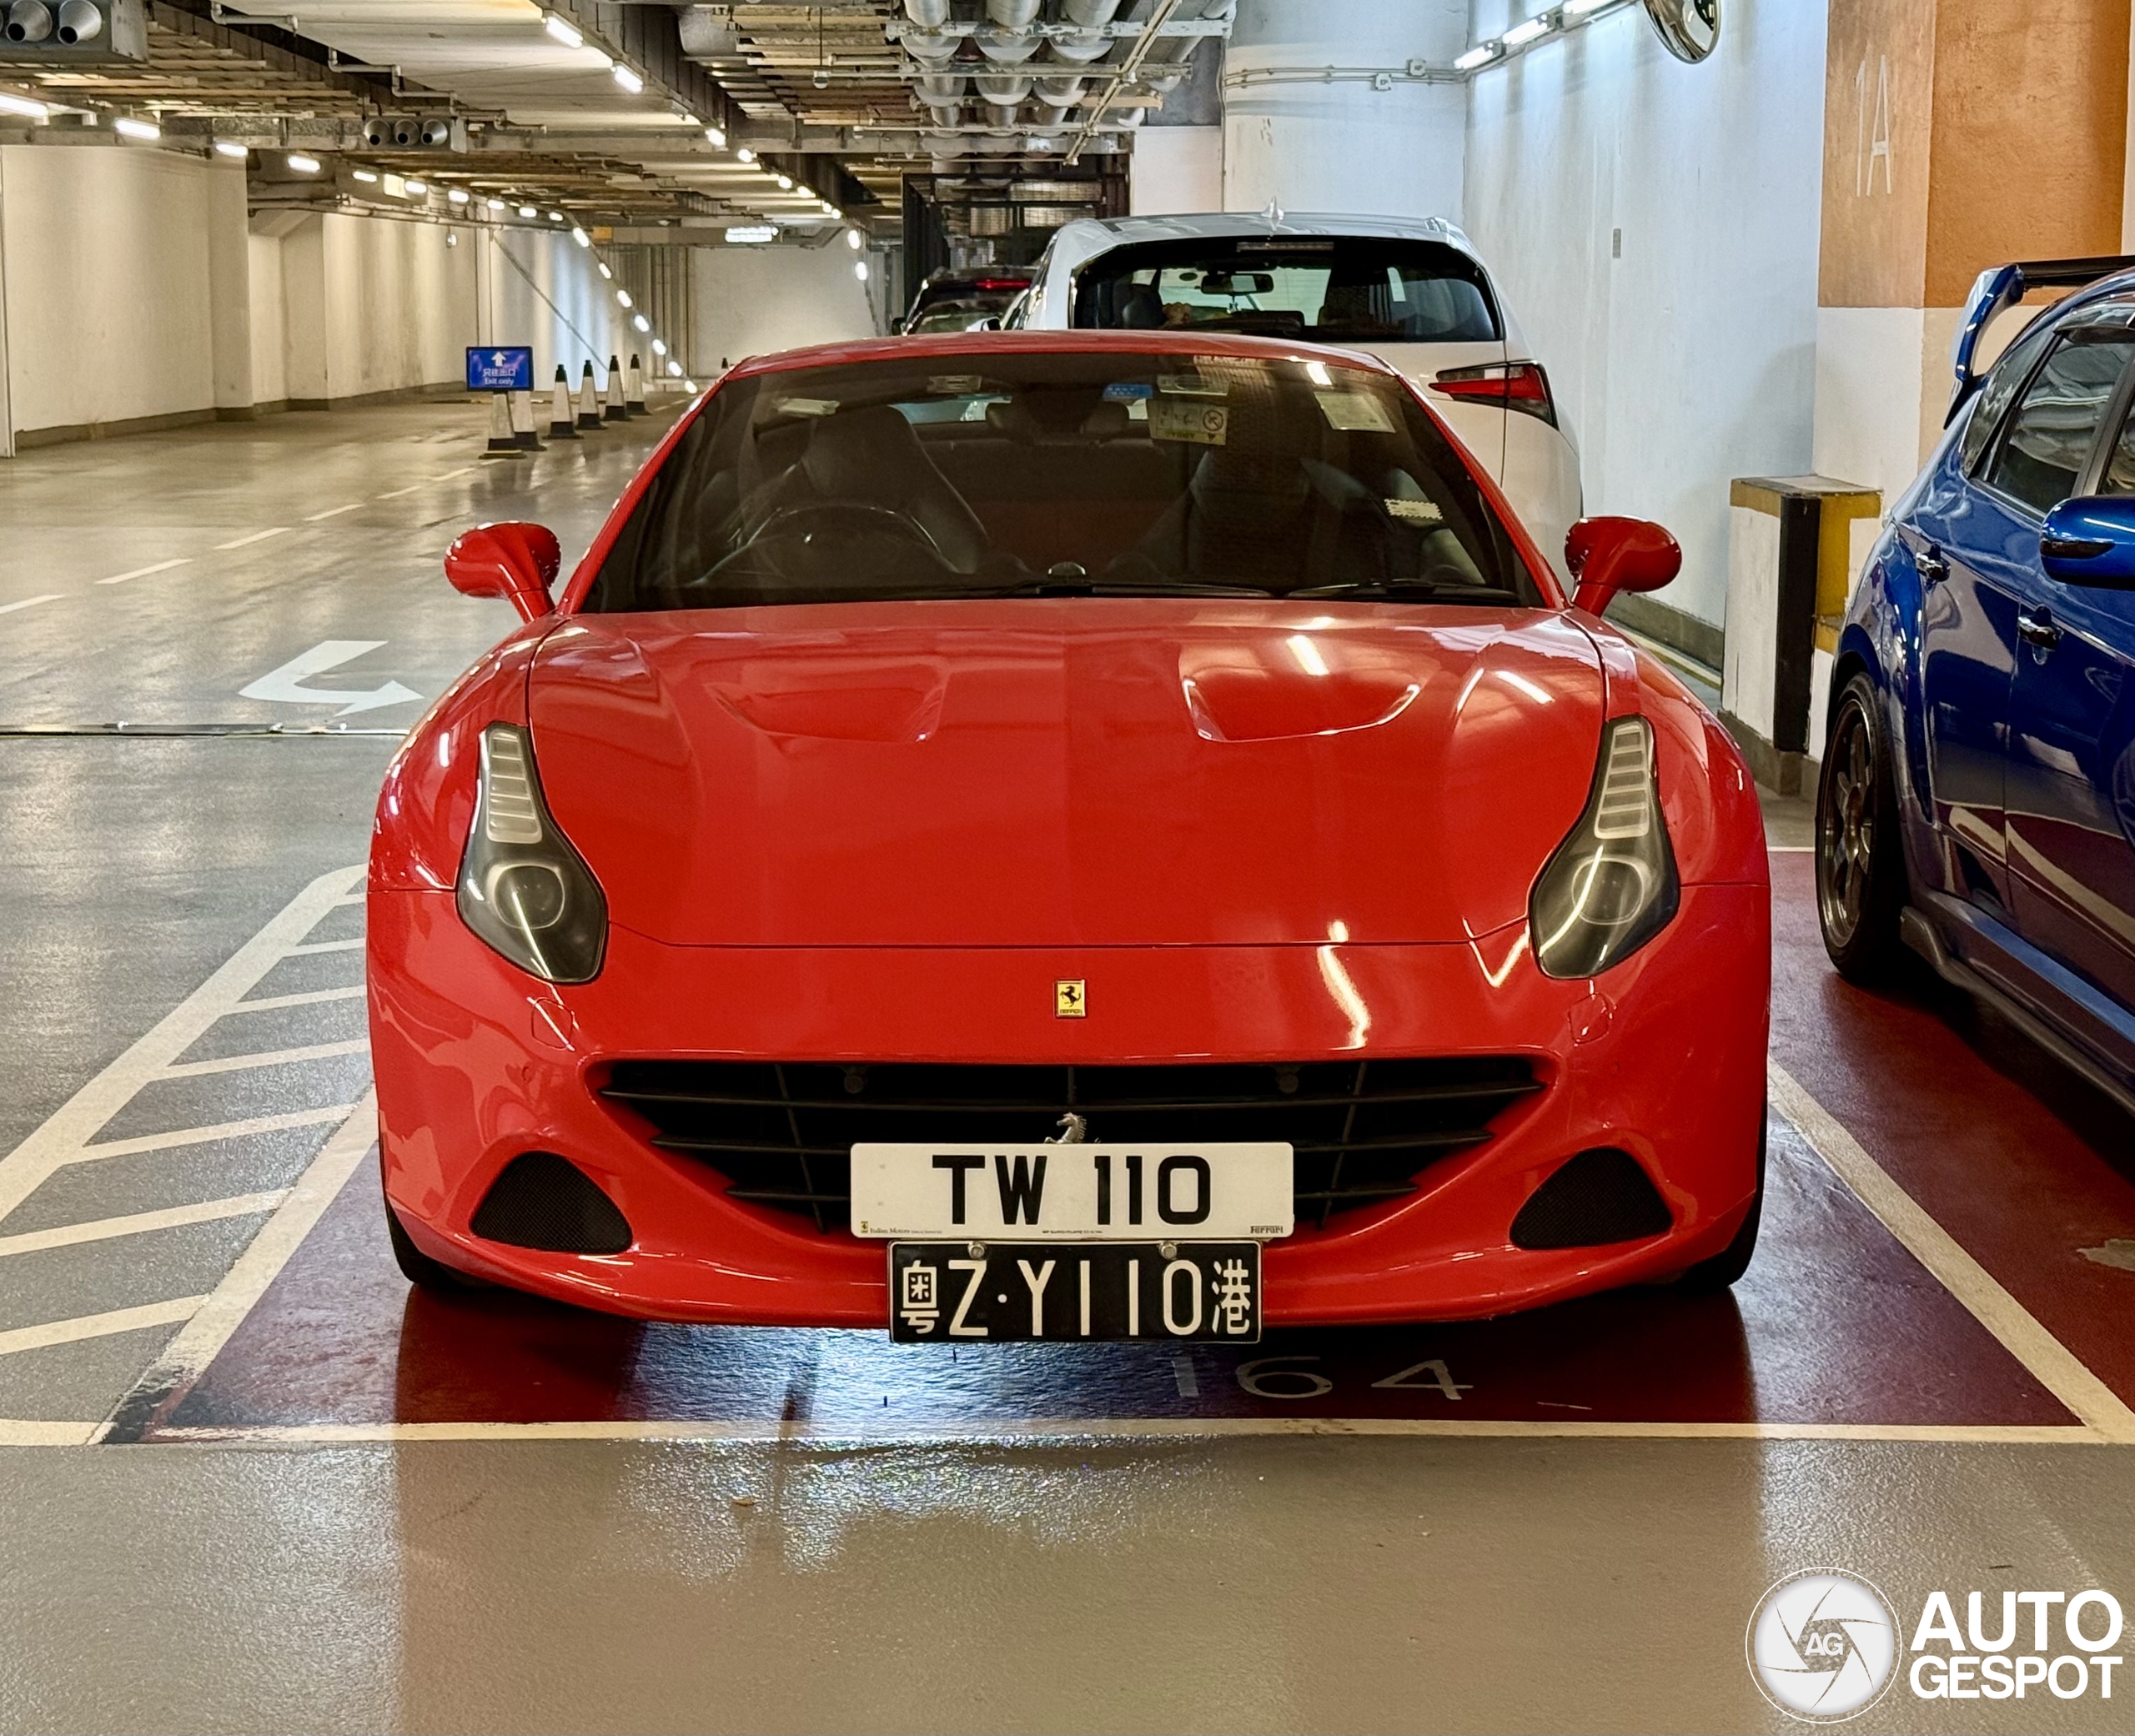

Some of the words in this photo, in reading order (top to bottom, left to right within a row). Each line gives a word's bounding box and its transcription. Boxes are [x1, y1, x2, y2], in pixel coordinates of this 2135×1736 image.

[498, 378, 514, 386] only
[932, 1155, 1047, 1226] TW
[1094, 1155, 1211, 1226] 110
[1250, 1225, 1284, 1234] Ferrari
[1171, 1355, 1474, 1401] 164
